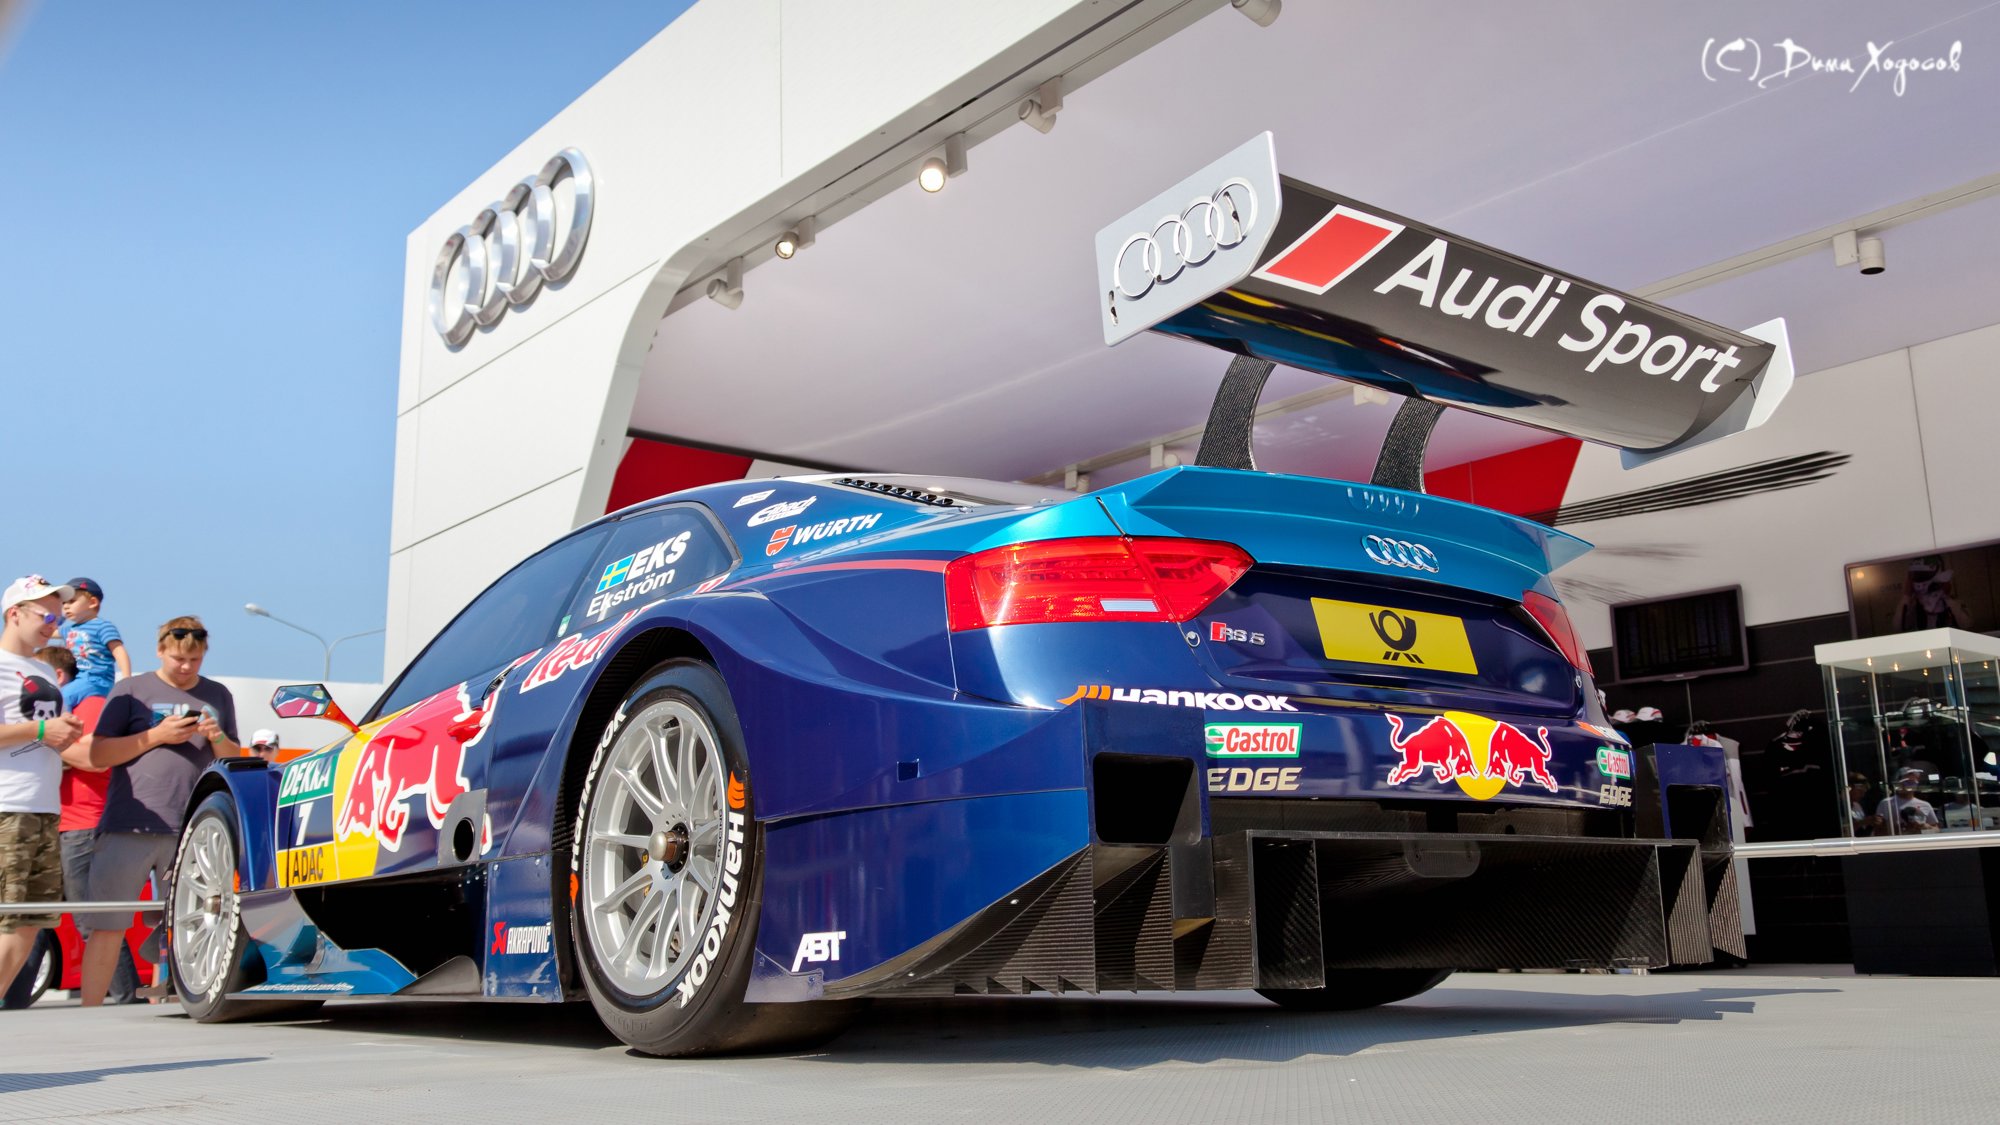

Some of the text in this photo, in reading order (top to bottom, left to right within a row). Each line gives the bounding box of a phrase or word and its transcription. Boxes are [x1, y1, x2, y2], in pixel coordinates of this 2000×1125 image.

[1373, 237, 1741, 393] Audi Sport
[793, 513, 883, 546] WÜRTH
[626, 531, 691, 581] EKS
[586, 569, 675, 617] Ekström
[1225, 727, 1296, 753] Castrol
[1207, 767, 1303, 792] EDGE
[1600, 784, 1633, 807] EDGE
[292, 847, 323, 884] ADAC
[791, 931, 847, 973] ABT
